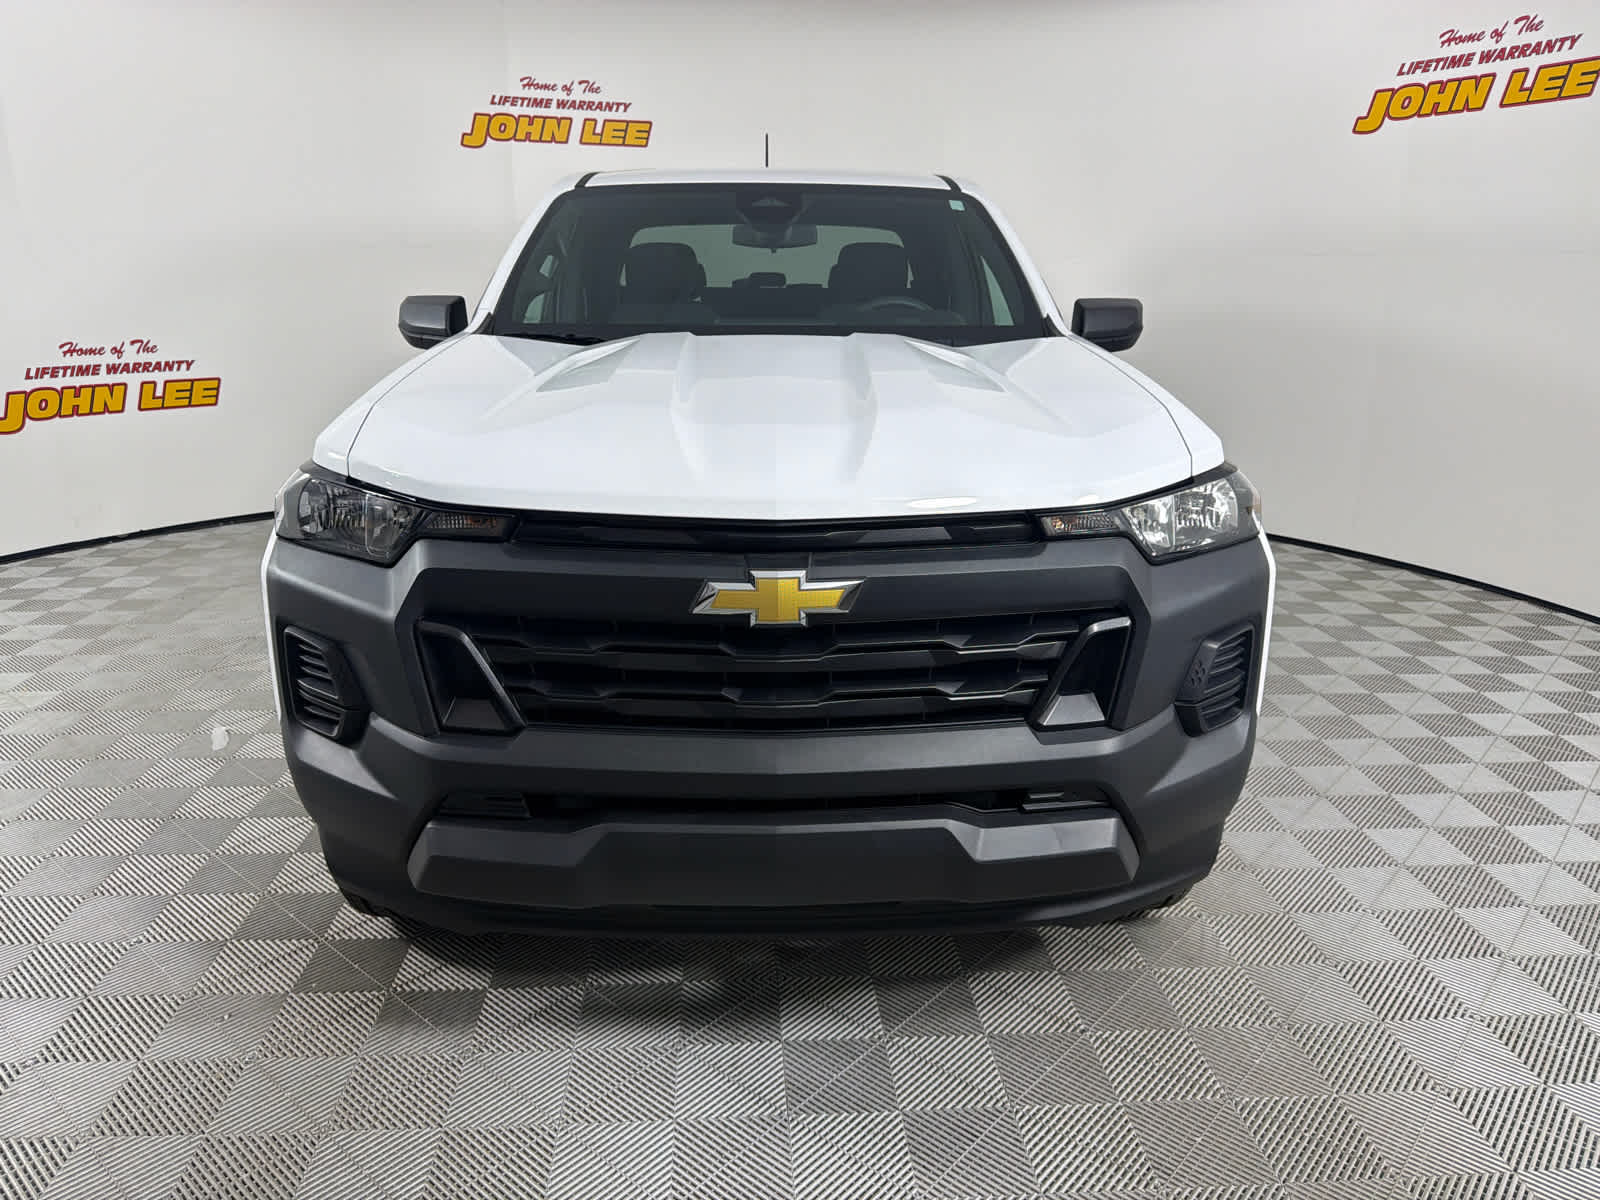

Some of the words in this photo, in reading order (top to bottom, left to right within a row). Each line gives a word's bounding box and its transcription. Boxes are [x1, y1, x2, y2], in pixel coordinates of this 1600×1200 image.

[1439, 28, 1485, 48] Home
[1490, 20, 1509, 44] of
[1514, 13, 1544, 36] The
[1396, 52, 1476, 77] LIFETIME
[1478, 33, 1584, 65] WARRANTY
[519, 76, 558, 92] Home
[561, 80, 576, 96] of
[578, 79, 602, 95] The
[1352, 72, 1497, 135] JOHN
[1499, 55, 1600, 108] LEE
[490, 95, 553, 110] LIFETIME
[556, 98, 632, 113] WARRANTY
[460, 112, 573, 148] JOHN
[579, 118, 653, 148] LEE
[58, 341, 105, 358] Home
[110, 341, 125, 359] of
[129, 339, 159, 355] The
[24, 363, 101, 380] LIFETIME
[106, 359, 195, 376] WARRANTY
[0, 382, 128, 435] JOHN
[137, 376, 221, 412] LEE
